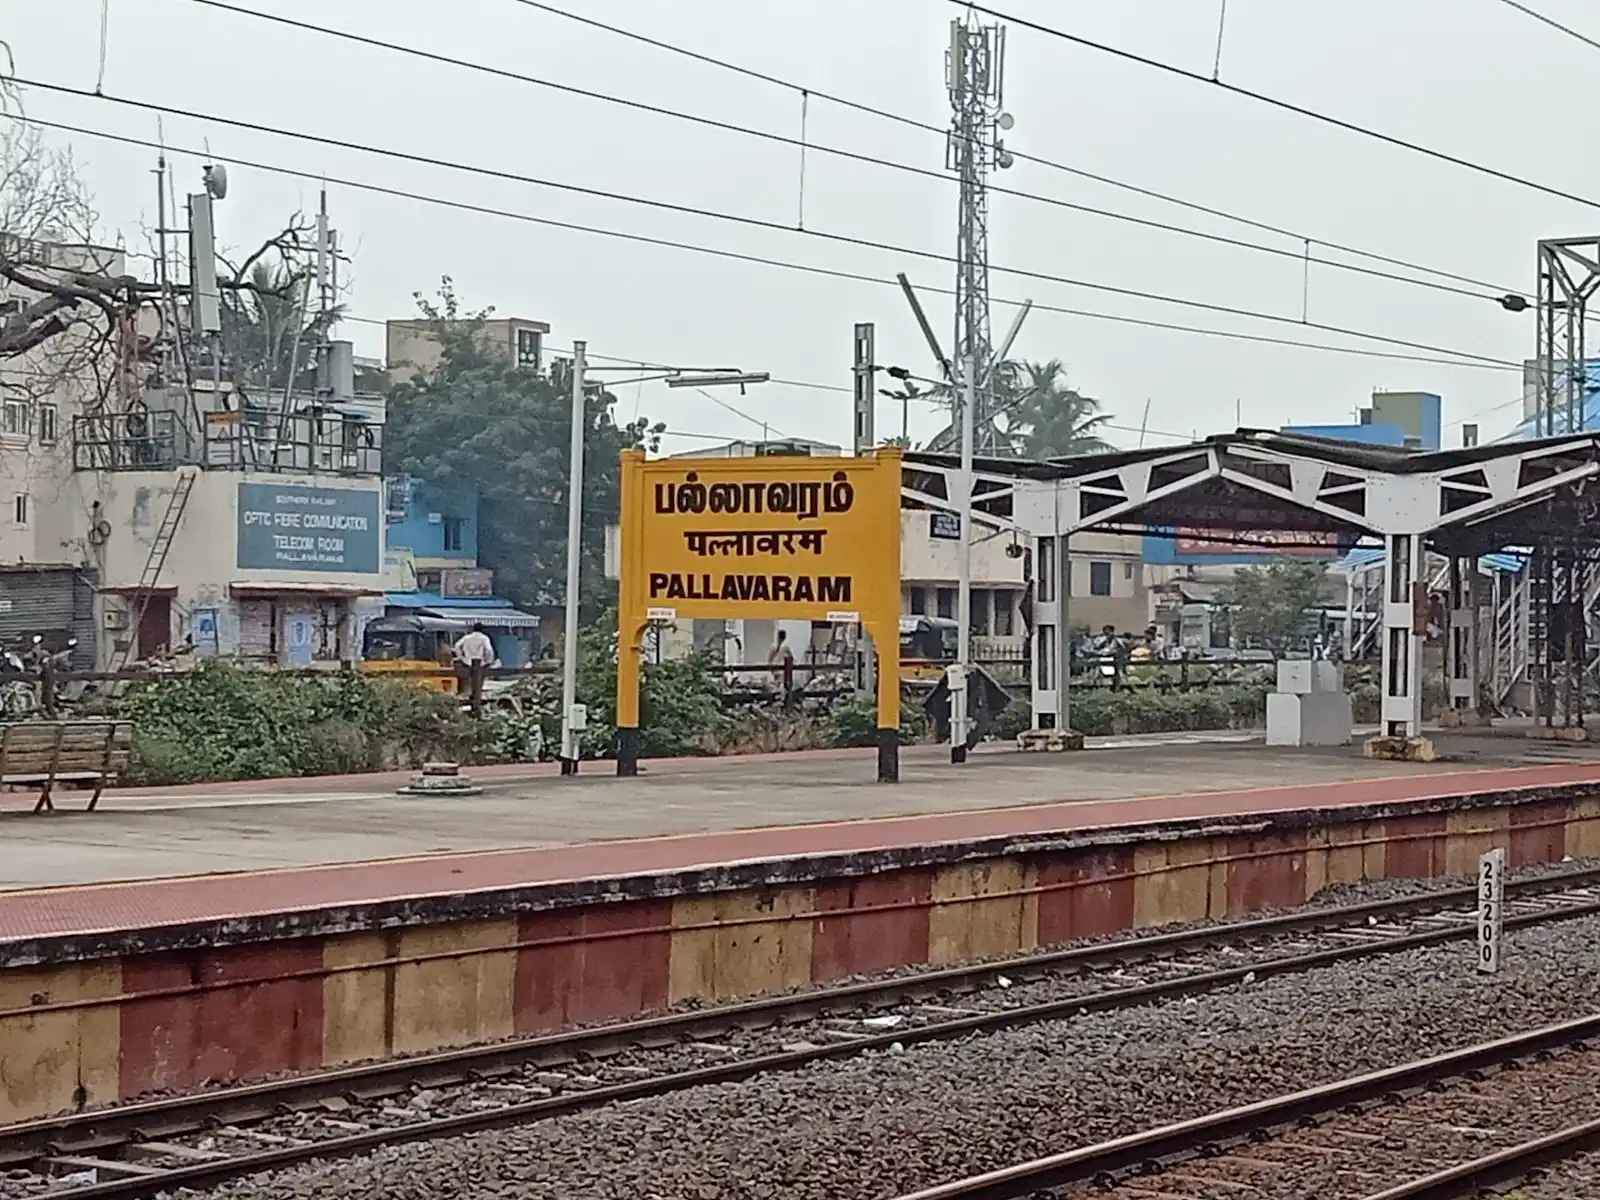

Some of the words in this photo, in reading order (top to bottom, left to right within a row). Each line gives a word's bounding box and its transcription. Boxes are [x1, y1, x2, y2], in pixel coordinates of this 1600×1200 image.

[655, 470, 854, 521] பல்லாவரம்
[272, 535, 315, 550] TELECOM
[317, 536, 345, 552] ROOM
[684, 528, 828, 556] पल्लावरम
[650, 572, 852, 602] PALLAVARAM
